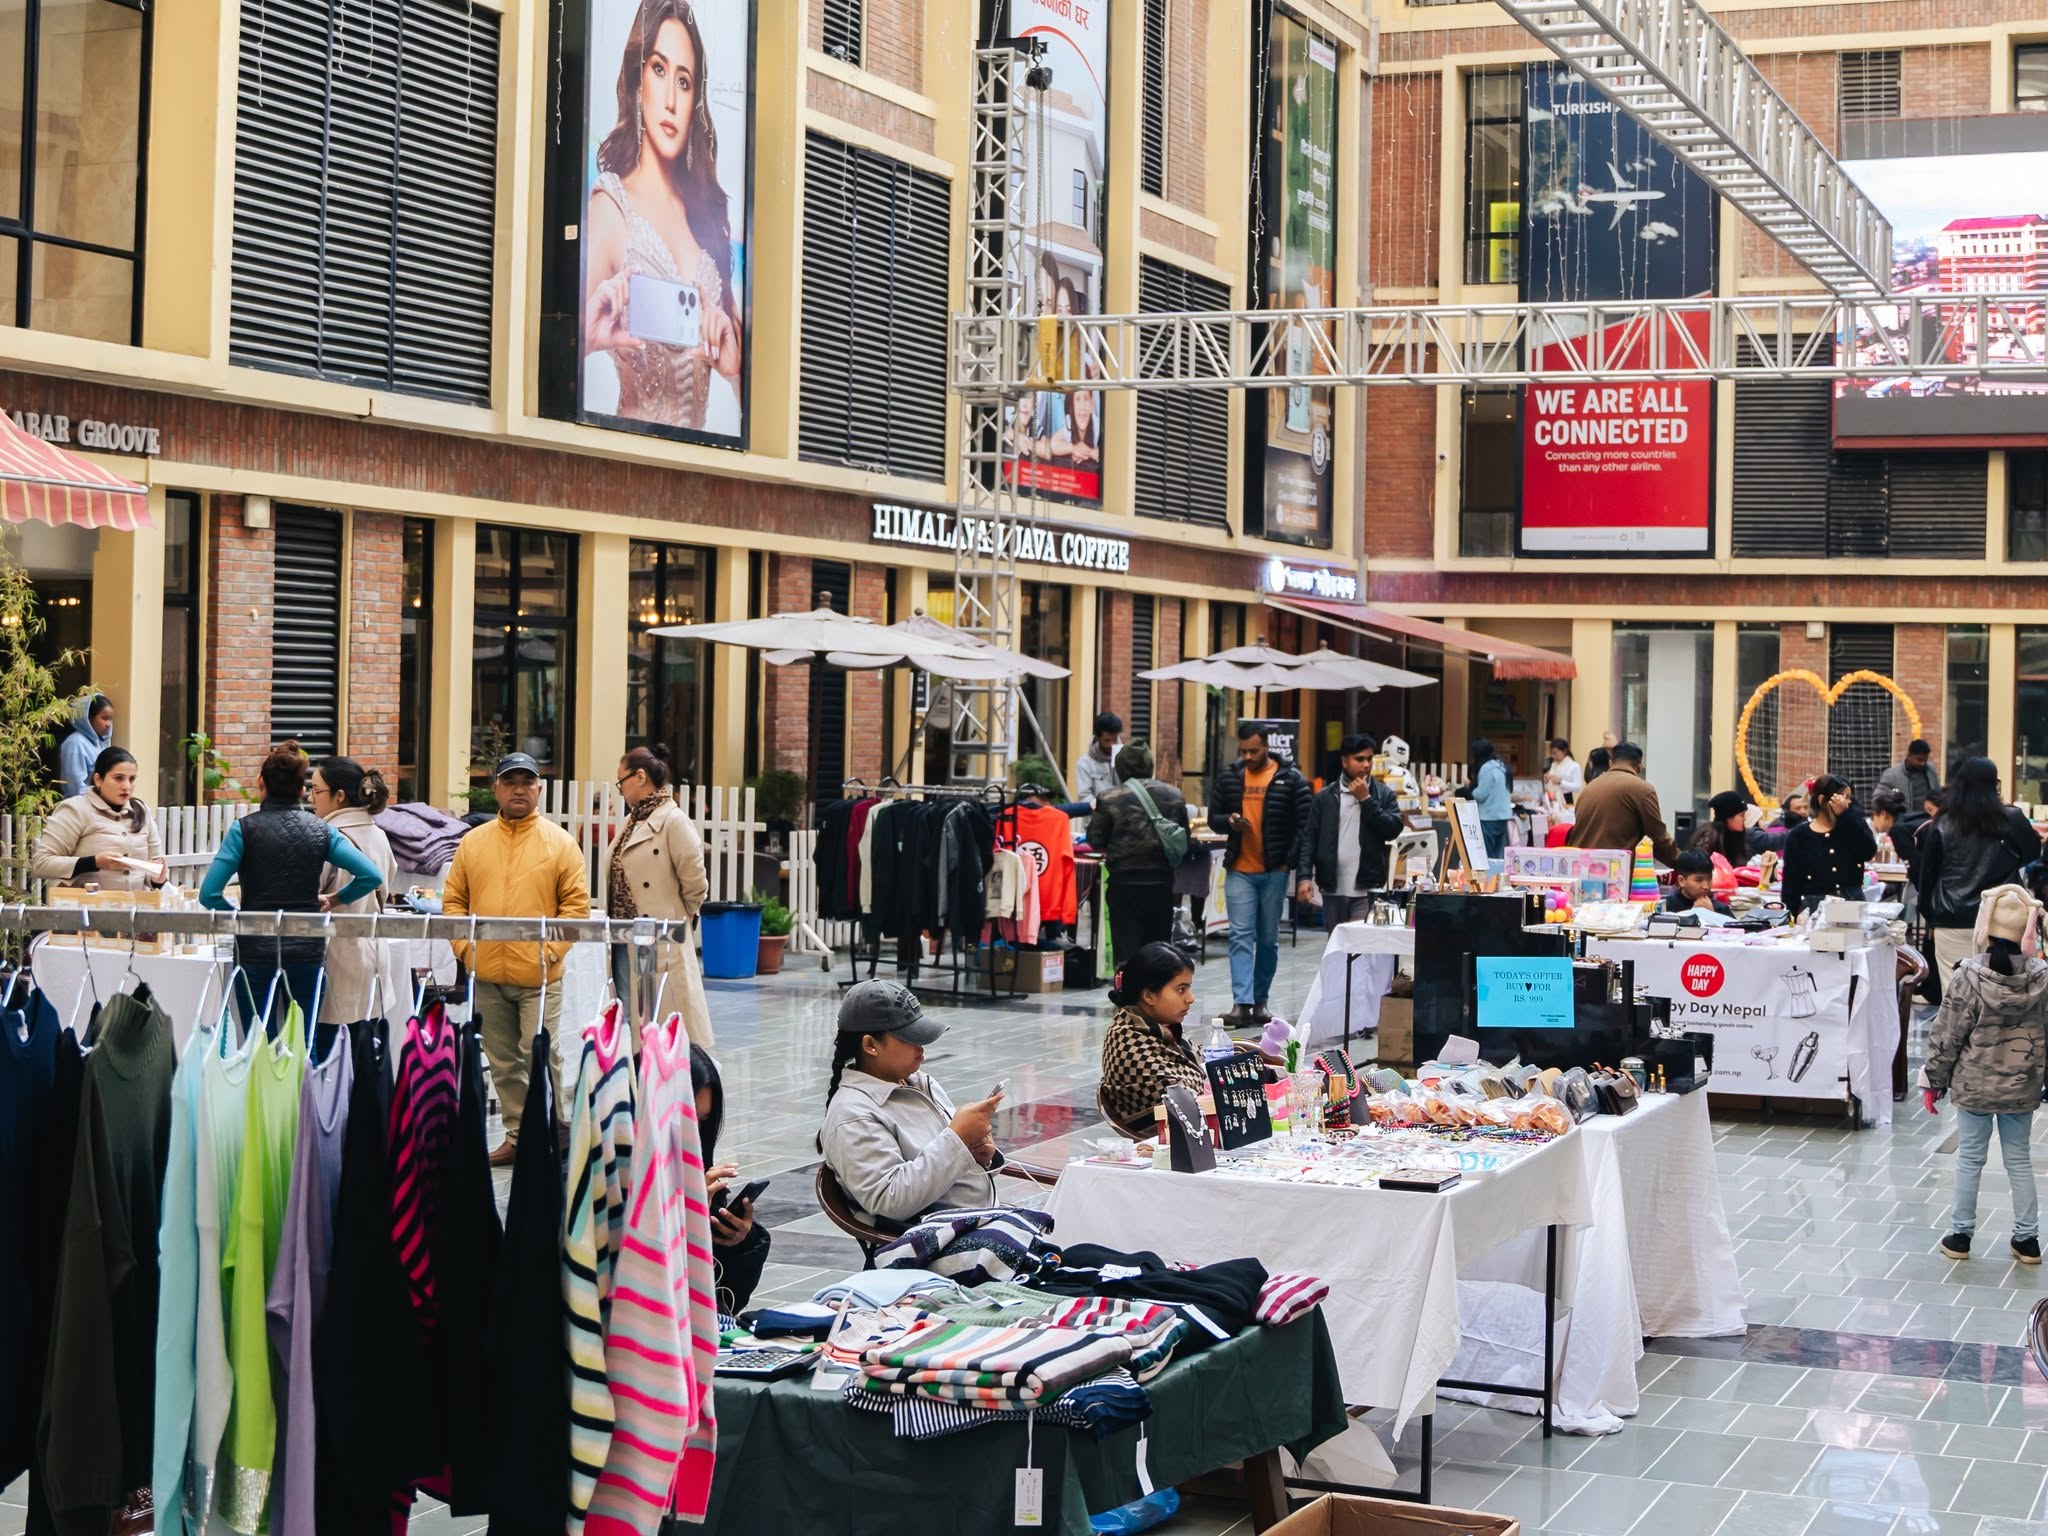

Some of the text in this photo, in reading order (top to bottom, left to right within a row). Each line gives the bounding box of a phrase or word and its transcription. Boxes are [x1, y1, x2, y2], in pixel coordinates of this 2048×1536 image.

[1553, 101, 1612, 116] TURKISH
[1534, 386, 1689, 415] WE ARE ALL
[3, 408, 161, 454] ABAR GROOVE
[1534, 418, 1689, 446] CONNECTED
[1544, 449, 1678, 462] Connecting more countries
[1558, 461, 1663, 474] than any other airline.
[1013, 525, 1058, 564] JAVA
[1060, 531, 1130, 572] COFFEE
[1493, 971, 1563, 981] TODAY'S OFFER
[1687, 964, 1719, 978] HAPPY
[1505, 982, 1552, 991] BUY FOR
[1691, 978, 1710, 991] DAY
[1513, 994, 1544, 1003] RS. 999
[1689, 1002, 1719, 1018] Day
[1722, 1003, 1767, 1020] Nepal
